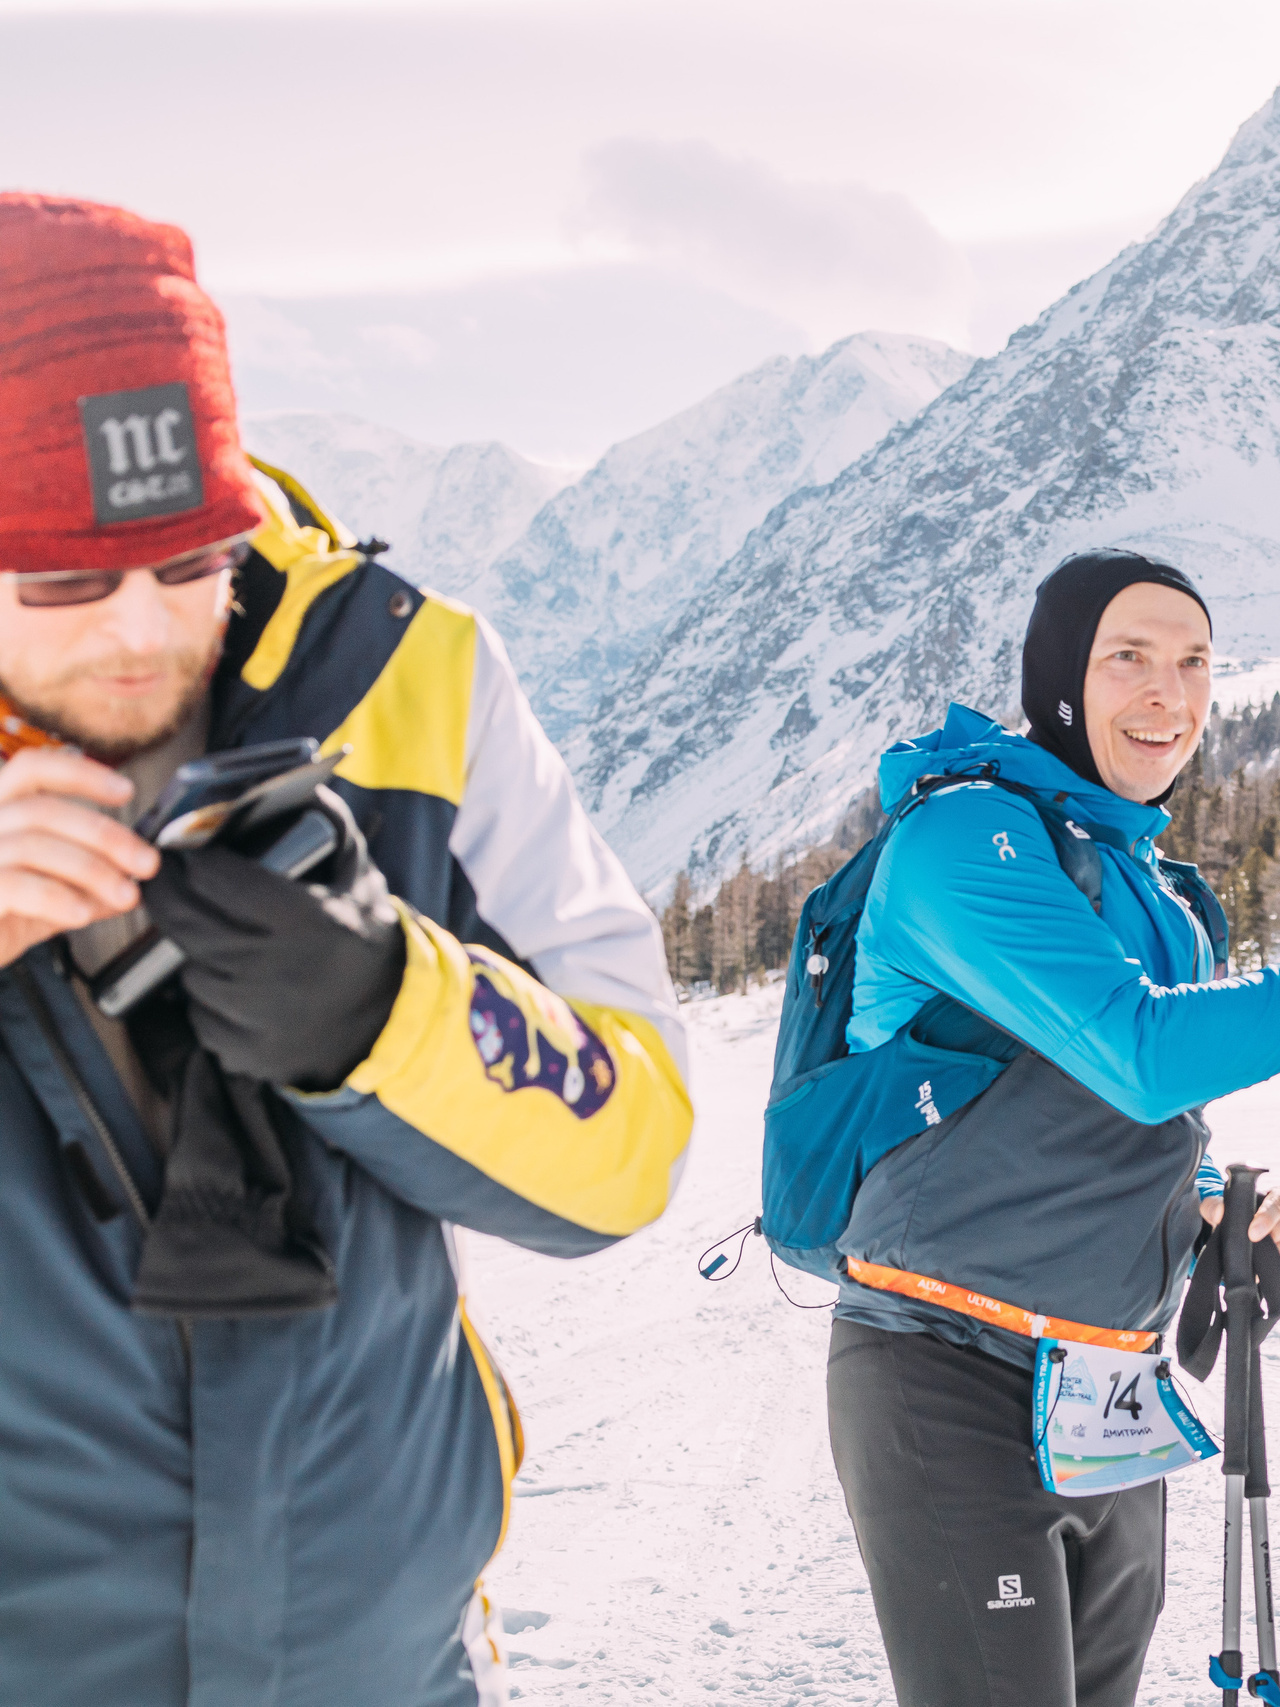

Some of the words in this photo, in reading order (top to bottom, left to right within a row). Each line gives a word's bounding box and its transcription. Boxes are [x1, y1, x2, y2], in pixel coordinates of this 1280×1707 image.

[917, 1278, 947, 1295] ALTAI
[966, 1293, 1002, 1314] ULTRA
[1103, 1370, 1143, 1420] 14
[1037, 1413, 1047, 1440] ALTAI
[1103, 1426, 1153, 1439] ДМИТРИЙ
[1176, 1409, 1195, 1431] WAUT
[1040, 1444, 1050, 1482] WINTER
